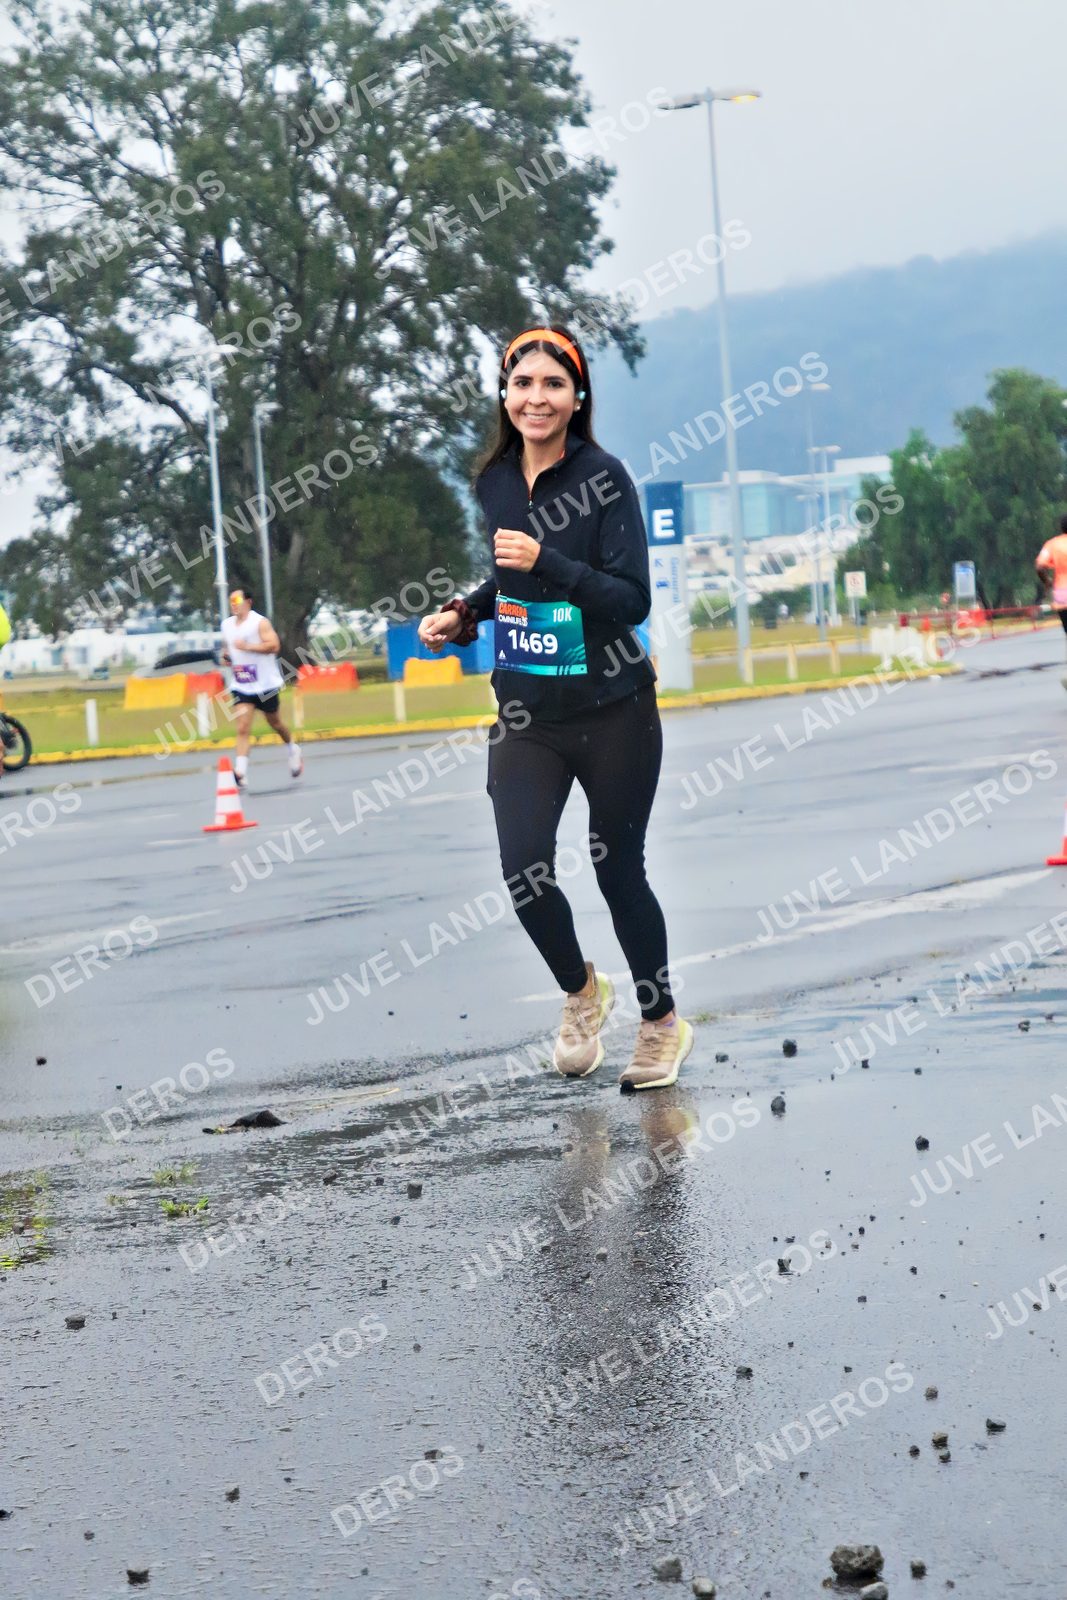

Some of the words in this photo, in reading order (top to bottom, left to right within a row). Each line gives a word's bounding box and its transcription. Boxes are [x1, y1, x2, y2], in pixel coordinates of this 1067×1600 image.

[653, 509, 675, 539] E
[498, 602, 527, 617] CARRERA
[552, 607, 572, 622] 10K
[508, 629, 558, 654] 1469
